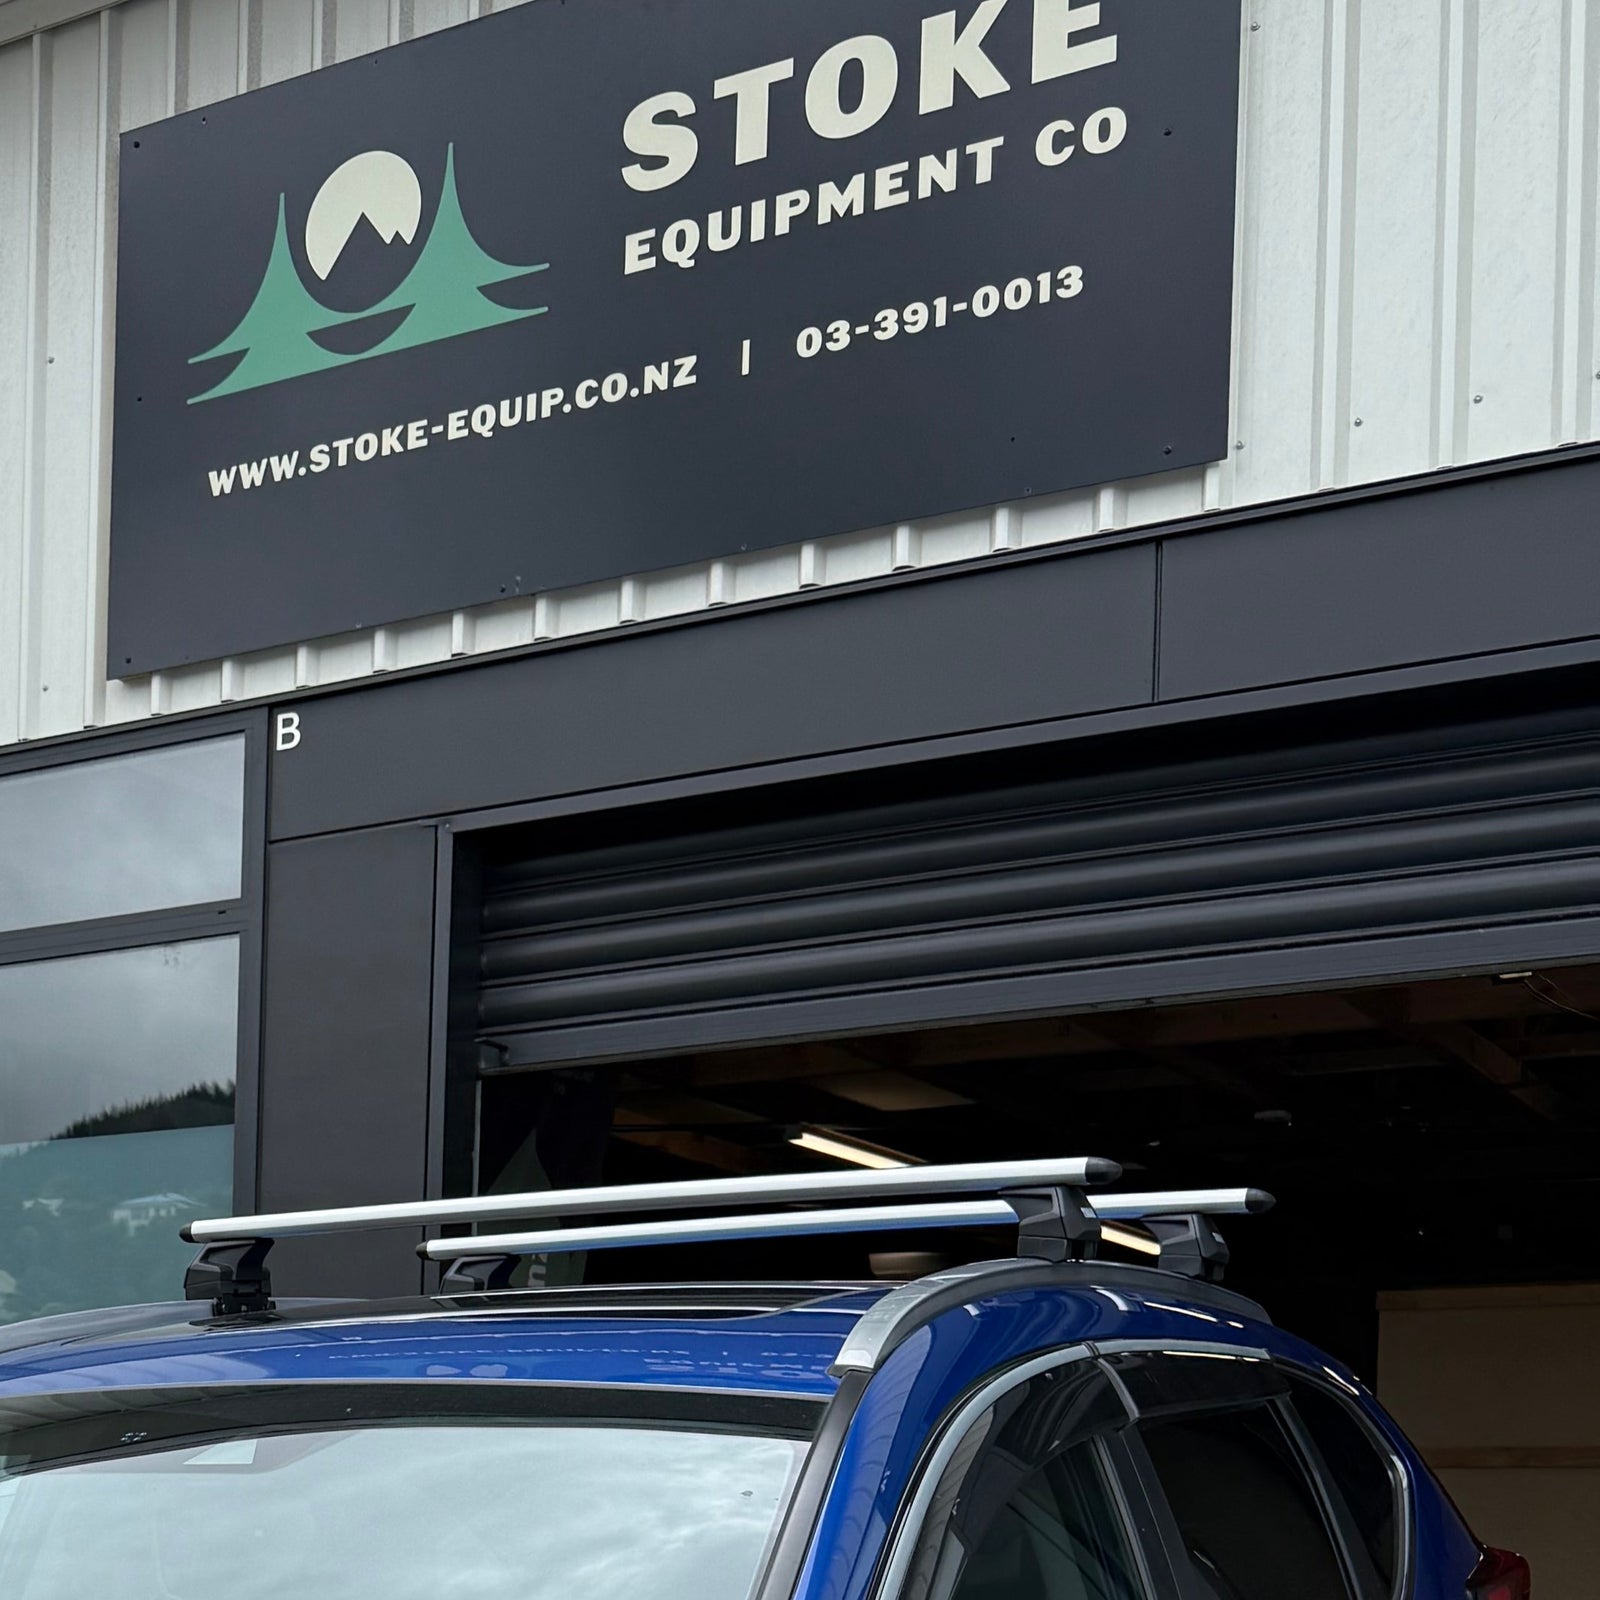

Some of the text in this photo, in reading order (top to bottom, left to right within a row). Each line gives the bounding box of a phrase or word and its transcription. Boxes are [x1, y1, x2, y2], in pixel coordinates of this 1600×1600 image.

[621, 0, 1118, 192] STOKE
[624, 106, 1127, 276] EQUIPMENT CO
[208, 354, 698, 498] WWW.STOKE-EQUIP.CO.NZ
[796, 265, 1085, 359] 03-391-0013
[276, 712, 301, 751] B
